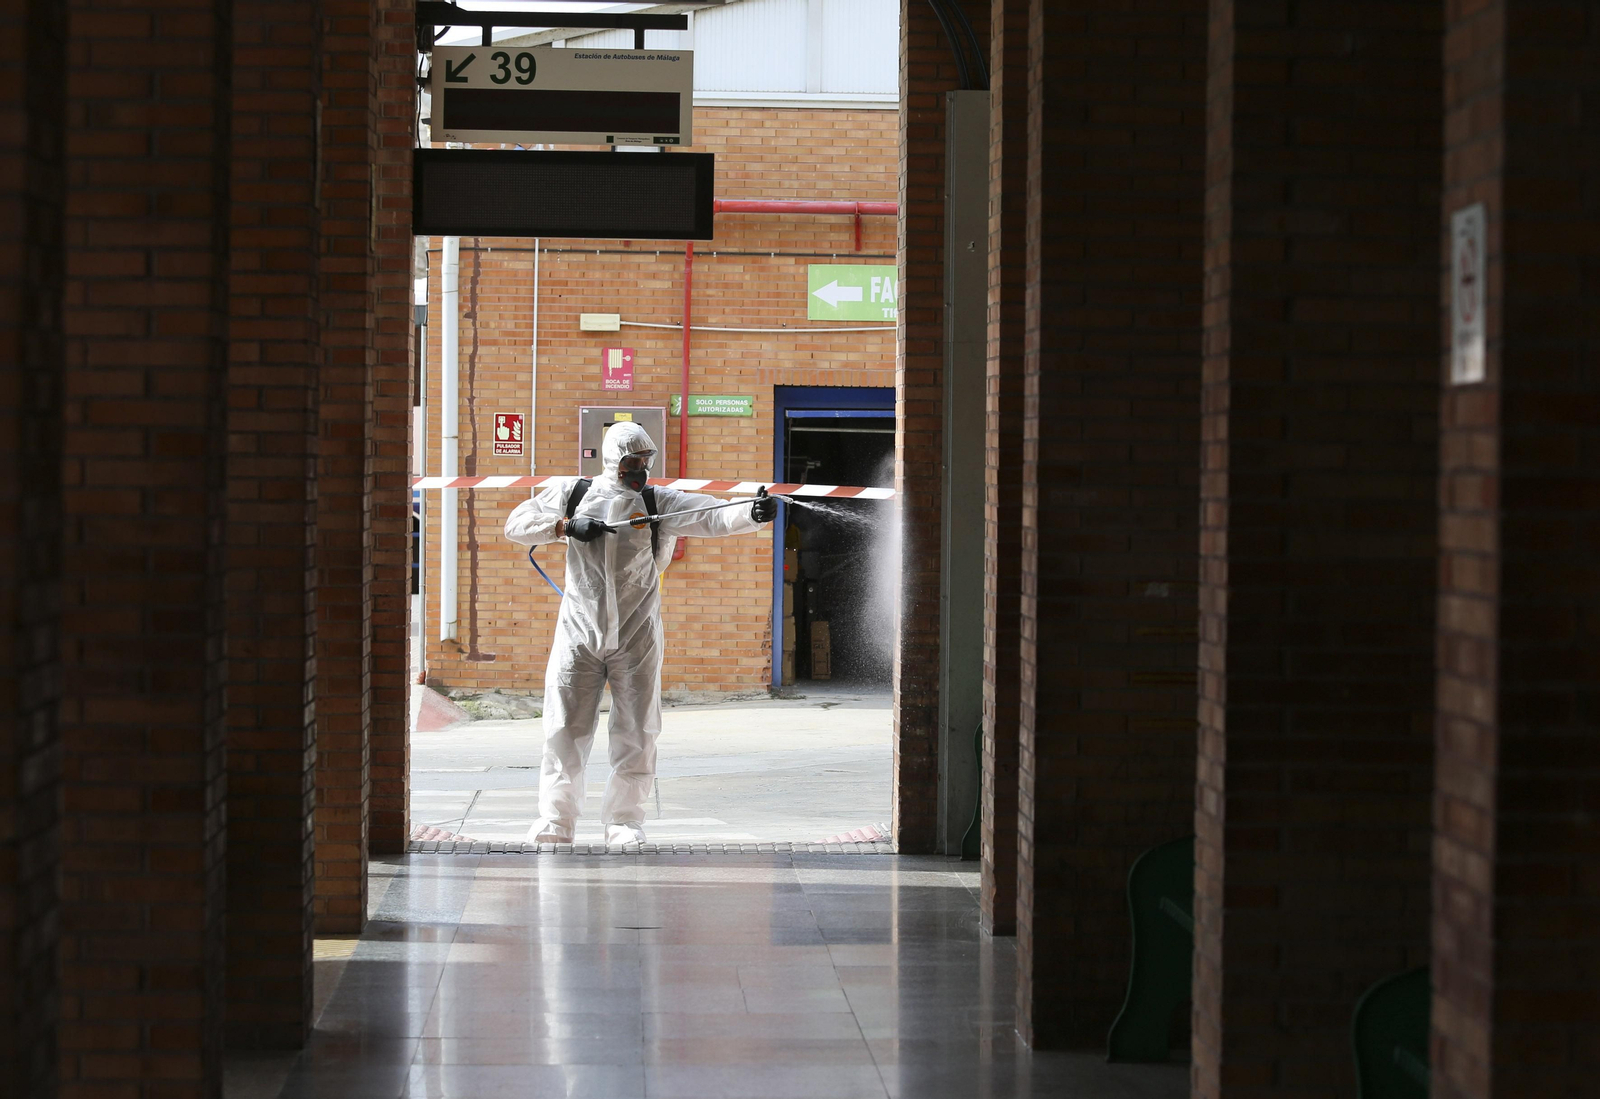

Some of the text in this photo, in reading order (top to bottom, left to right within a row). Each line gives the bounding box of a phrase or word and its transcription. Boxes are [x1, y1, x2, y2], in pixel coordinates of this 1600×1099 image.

[489, 51, 537, 85] 39
[612, 53, 646, 61] Autobuses
[656, 54, 680, 62] Málaga
[870, 276, 898, 303] FA
